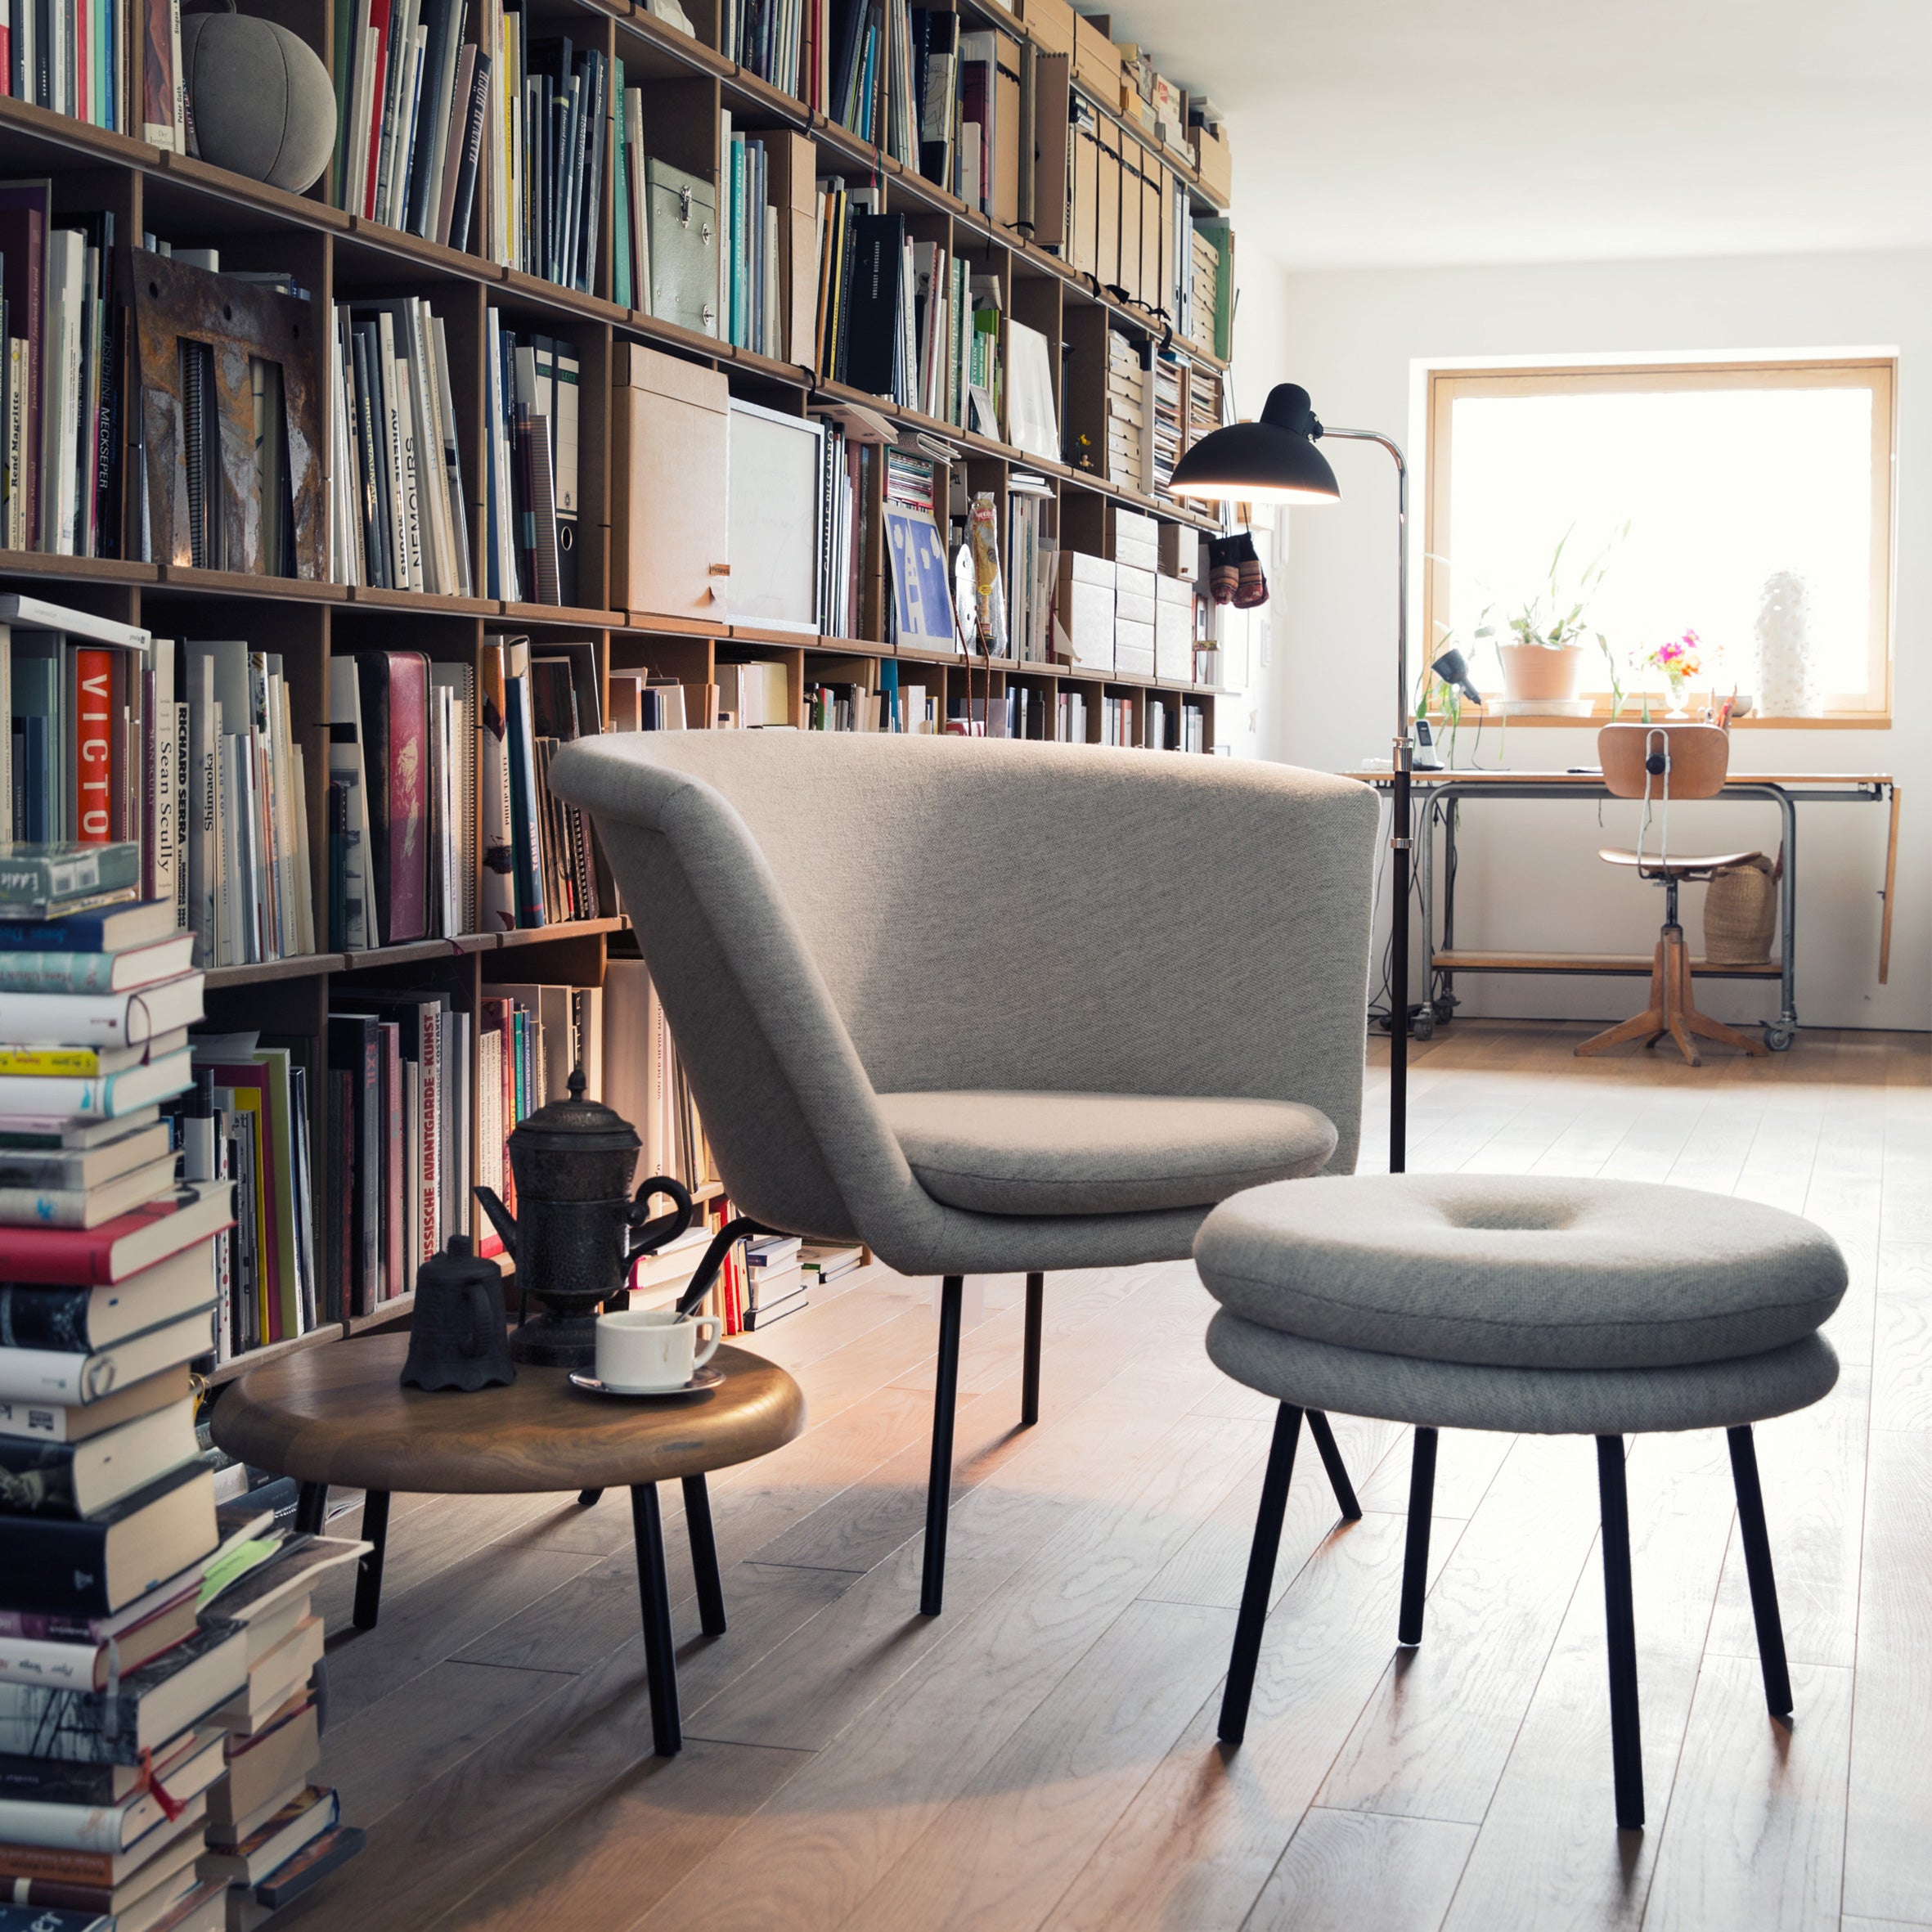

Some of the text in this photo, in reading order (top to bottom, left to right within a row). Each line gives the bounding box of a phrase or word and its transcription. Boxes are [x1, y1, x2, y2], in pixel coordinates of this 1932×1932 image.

[469, 70, 489, 164] HANNAH HÖCH
[951, 299, 959, 349] Garden
[538, 366, 550, 375] LEITZ
[562, 371, 576, 384] LEITZ
[950, 352, 958, 399] Book
[11, 392, 20, 452] Magritte
[99, 330, 112, 489] JOSEPHINE MECKSEPER
[365, 398, 373, 443] BRUCE
[391, 409, 400, 483] AURELIE
[406, 437, 421, 567] NEMOURS
[82, 674, 109, 834] VICTO
[177, 708, 187, 845] RICHARD SERRA
[158, 742, 173, 873] Sean Scully
[204, 753, 213, 832] Shimaoka
[366, 1043, 377, 1089] EXIL
[424, 1015, 435, 1067] KUNST
[424, 1076, 435, 1180] AVANTGARDE
[425, 1187, 435, 1262] USSISCHE
